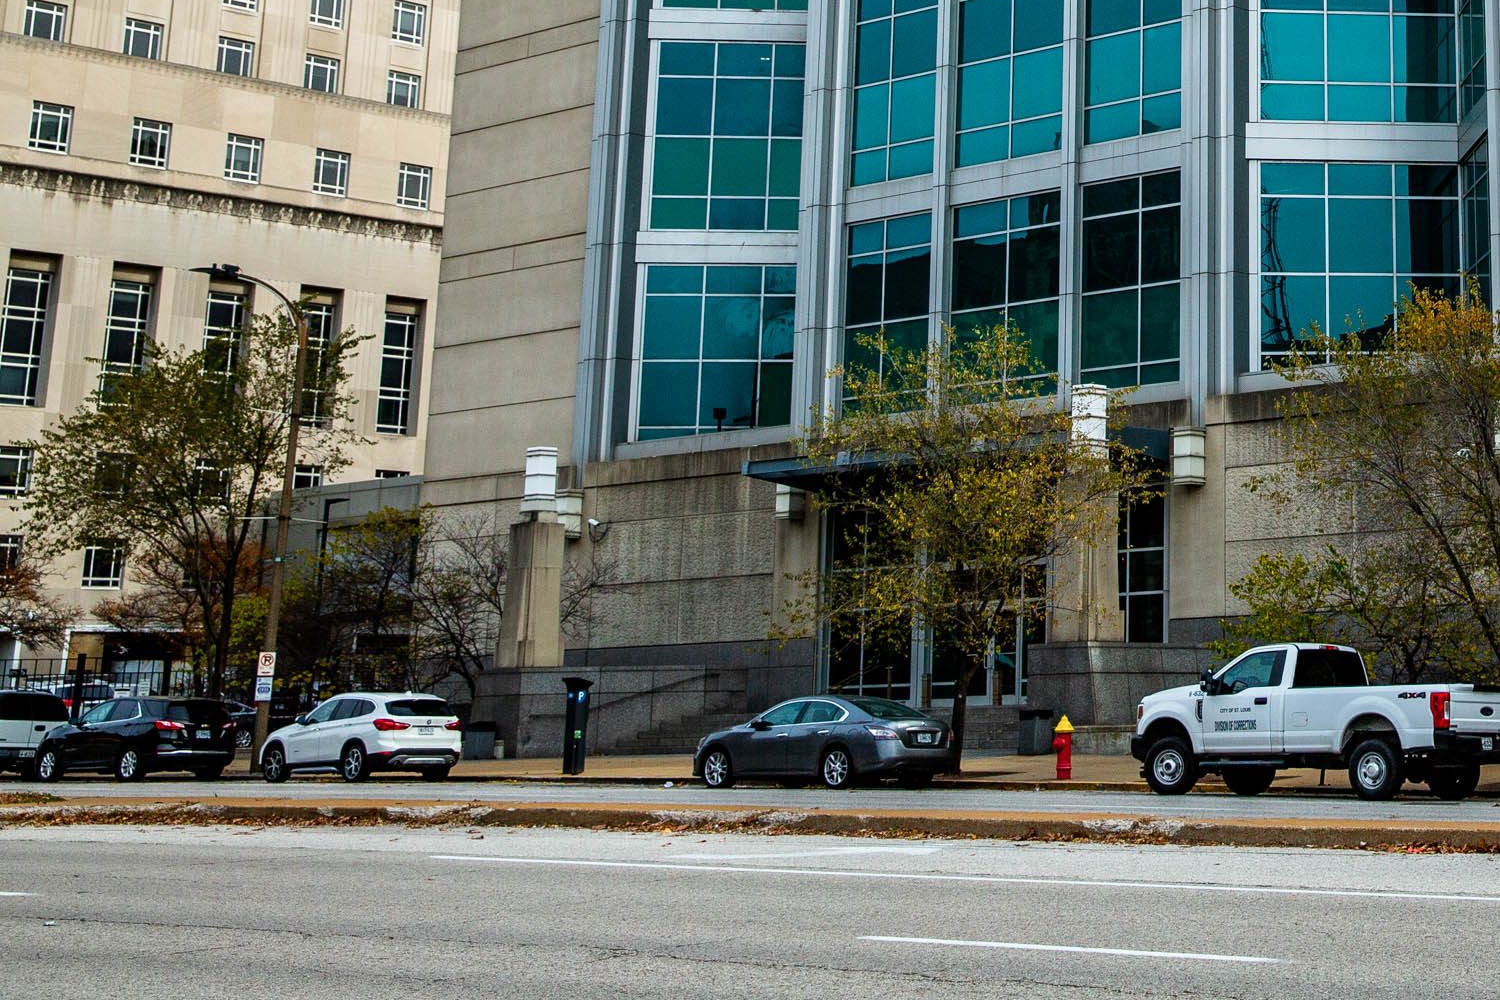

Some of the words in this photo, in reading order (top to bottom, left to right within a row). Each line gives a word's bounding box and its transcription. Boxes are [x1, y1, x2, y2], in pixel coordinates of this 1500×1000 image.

[1214, 720, 1228, 732] DIVISION
[1229, 720, 1233, 731] OF
[1234, 719, 1256, 731] CORRECTIONS
